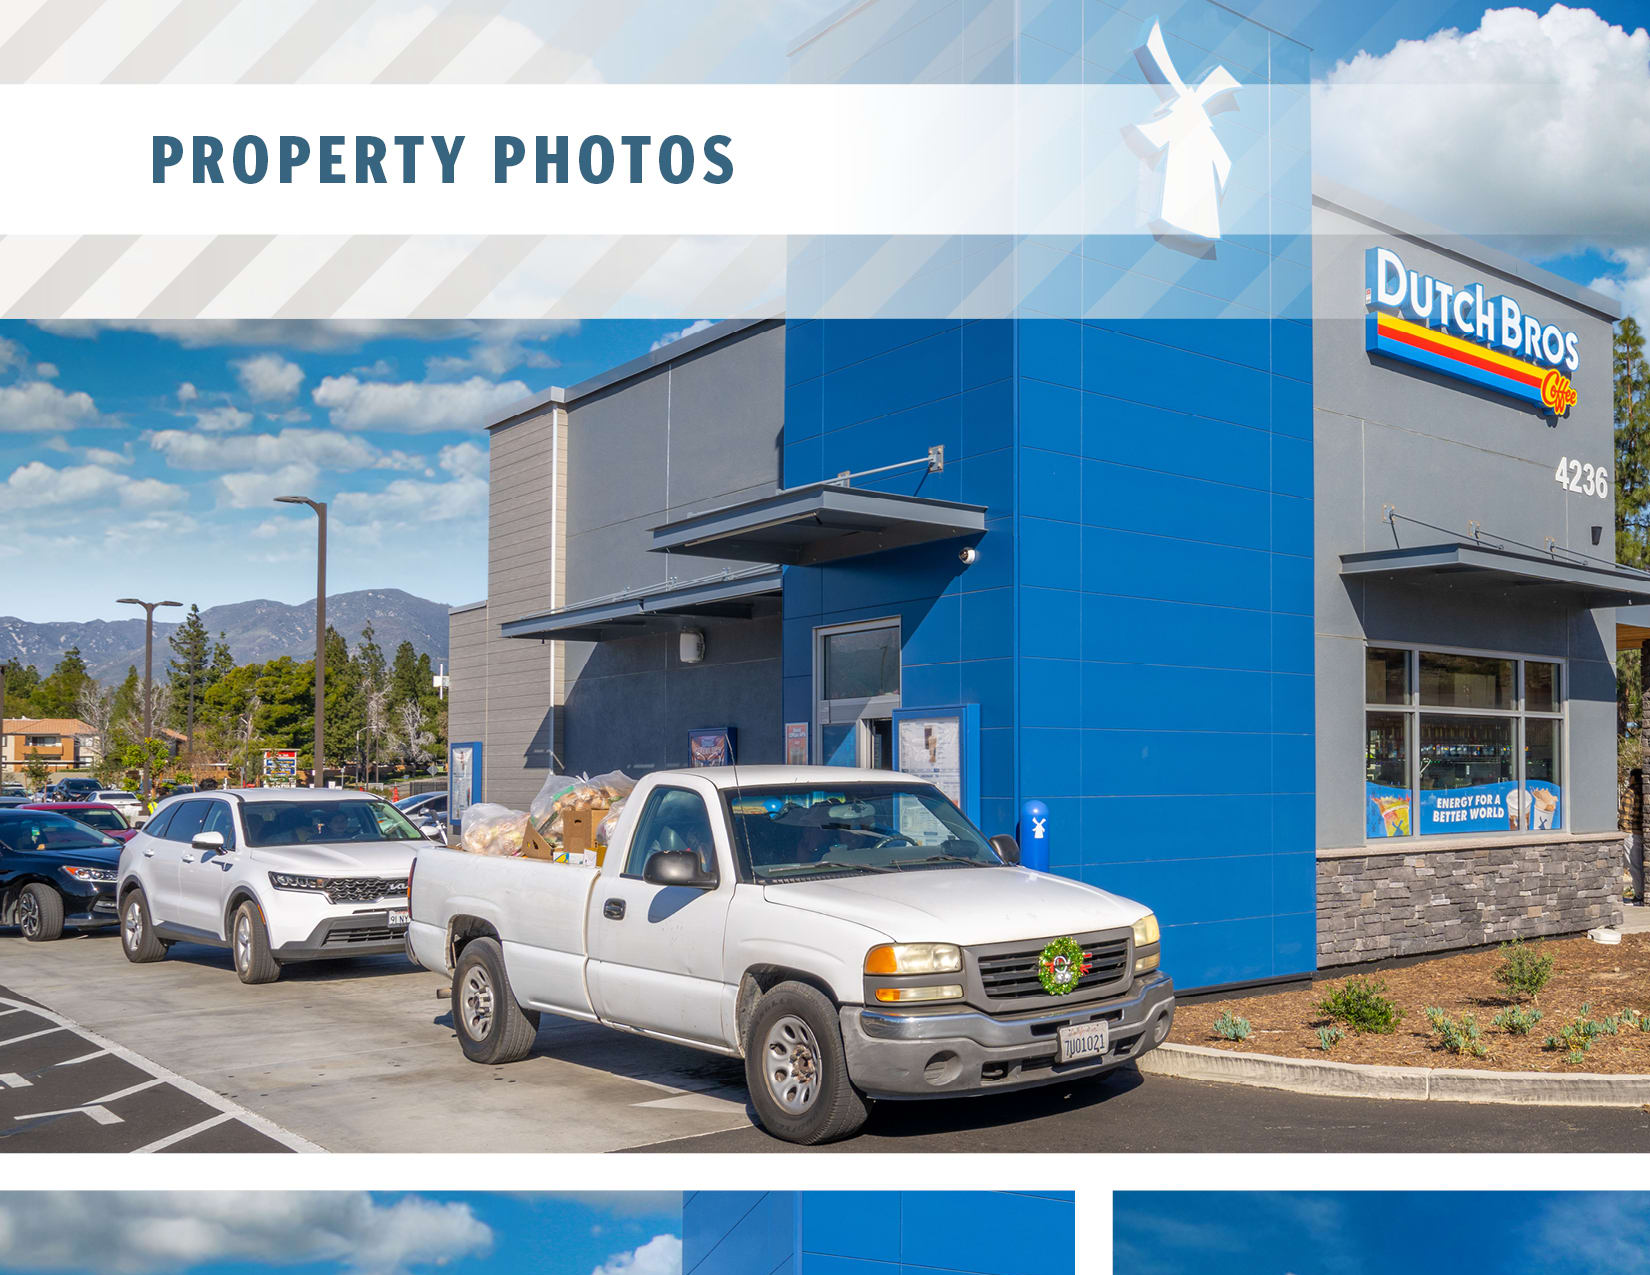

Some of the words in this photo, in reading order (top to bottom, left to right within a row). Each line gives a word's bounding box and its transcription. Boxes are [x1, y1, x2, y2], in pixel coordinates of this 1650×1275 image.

[1502, 295, 1580, 372] BROS
[1541, 369, 1577, 414] Coffee
[1555, 456, 1608, 499] 4236
[1433, 810, 1467, 823] BETTER
[1469, 807, 1504, 820] WORLD
[1437, 796, 1473, 808] ENERGY
[1475, 794, 1492, 806] FOR
[1494, 794, 1501, 805] A
[1064, 1034, 1105, 1056] 7U01021
